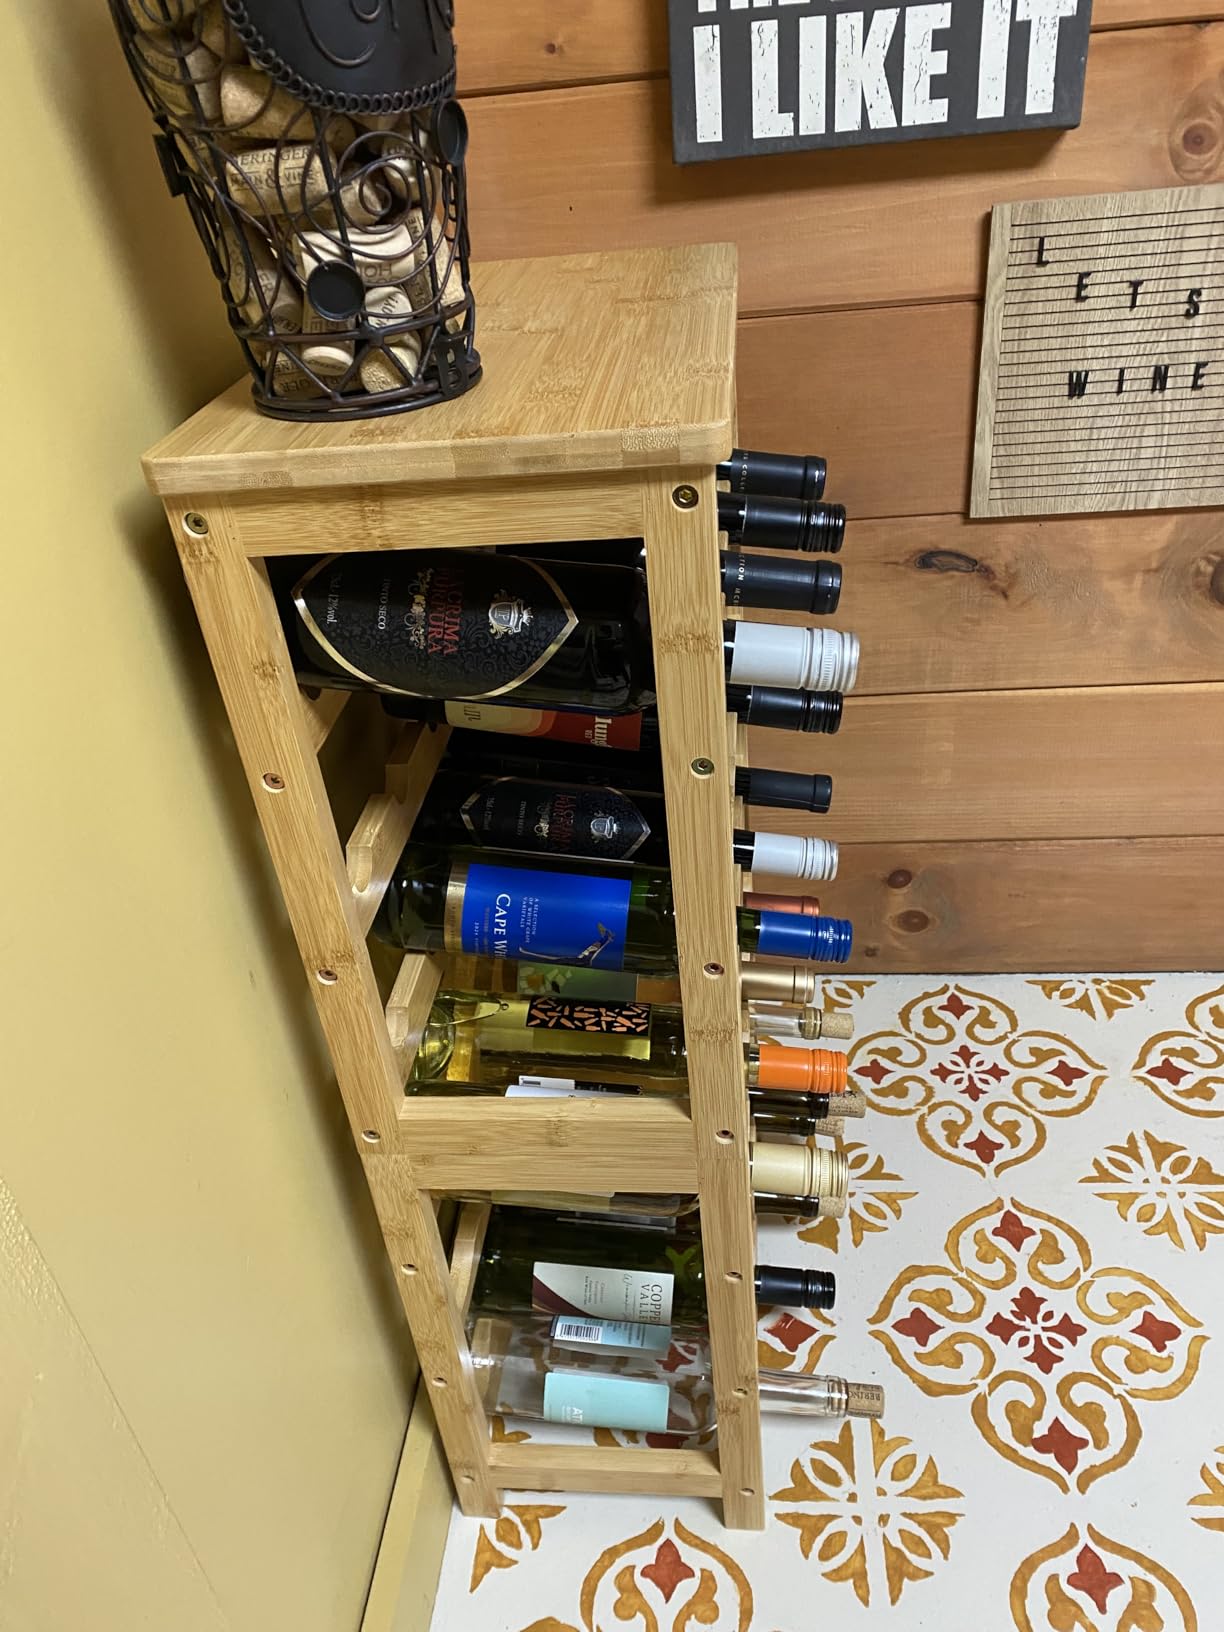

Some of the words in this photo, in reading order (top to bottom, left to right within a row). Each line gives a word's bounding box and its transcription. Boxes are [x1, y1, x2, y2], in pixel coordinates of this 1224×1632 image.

[693, 25, 723, 143] I
[750, 3, 952, 139] LIKE
[976, 0, 1079, 120] IT
[1067, 362, 1208, 399] WINE
[377, 605, 388, 630] SECO
[493, 893, 512, 936] CAPE
[525, 906, 533, 927] WHITE
[530, 903, 539, 936] SELECTION
